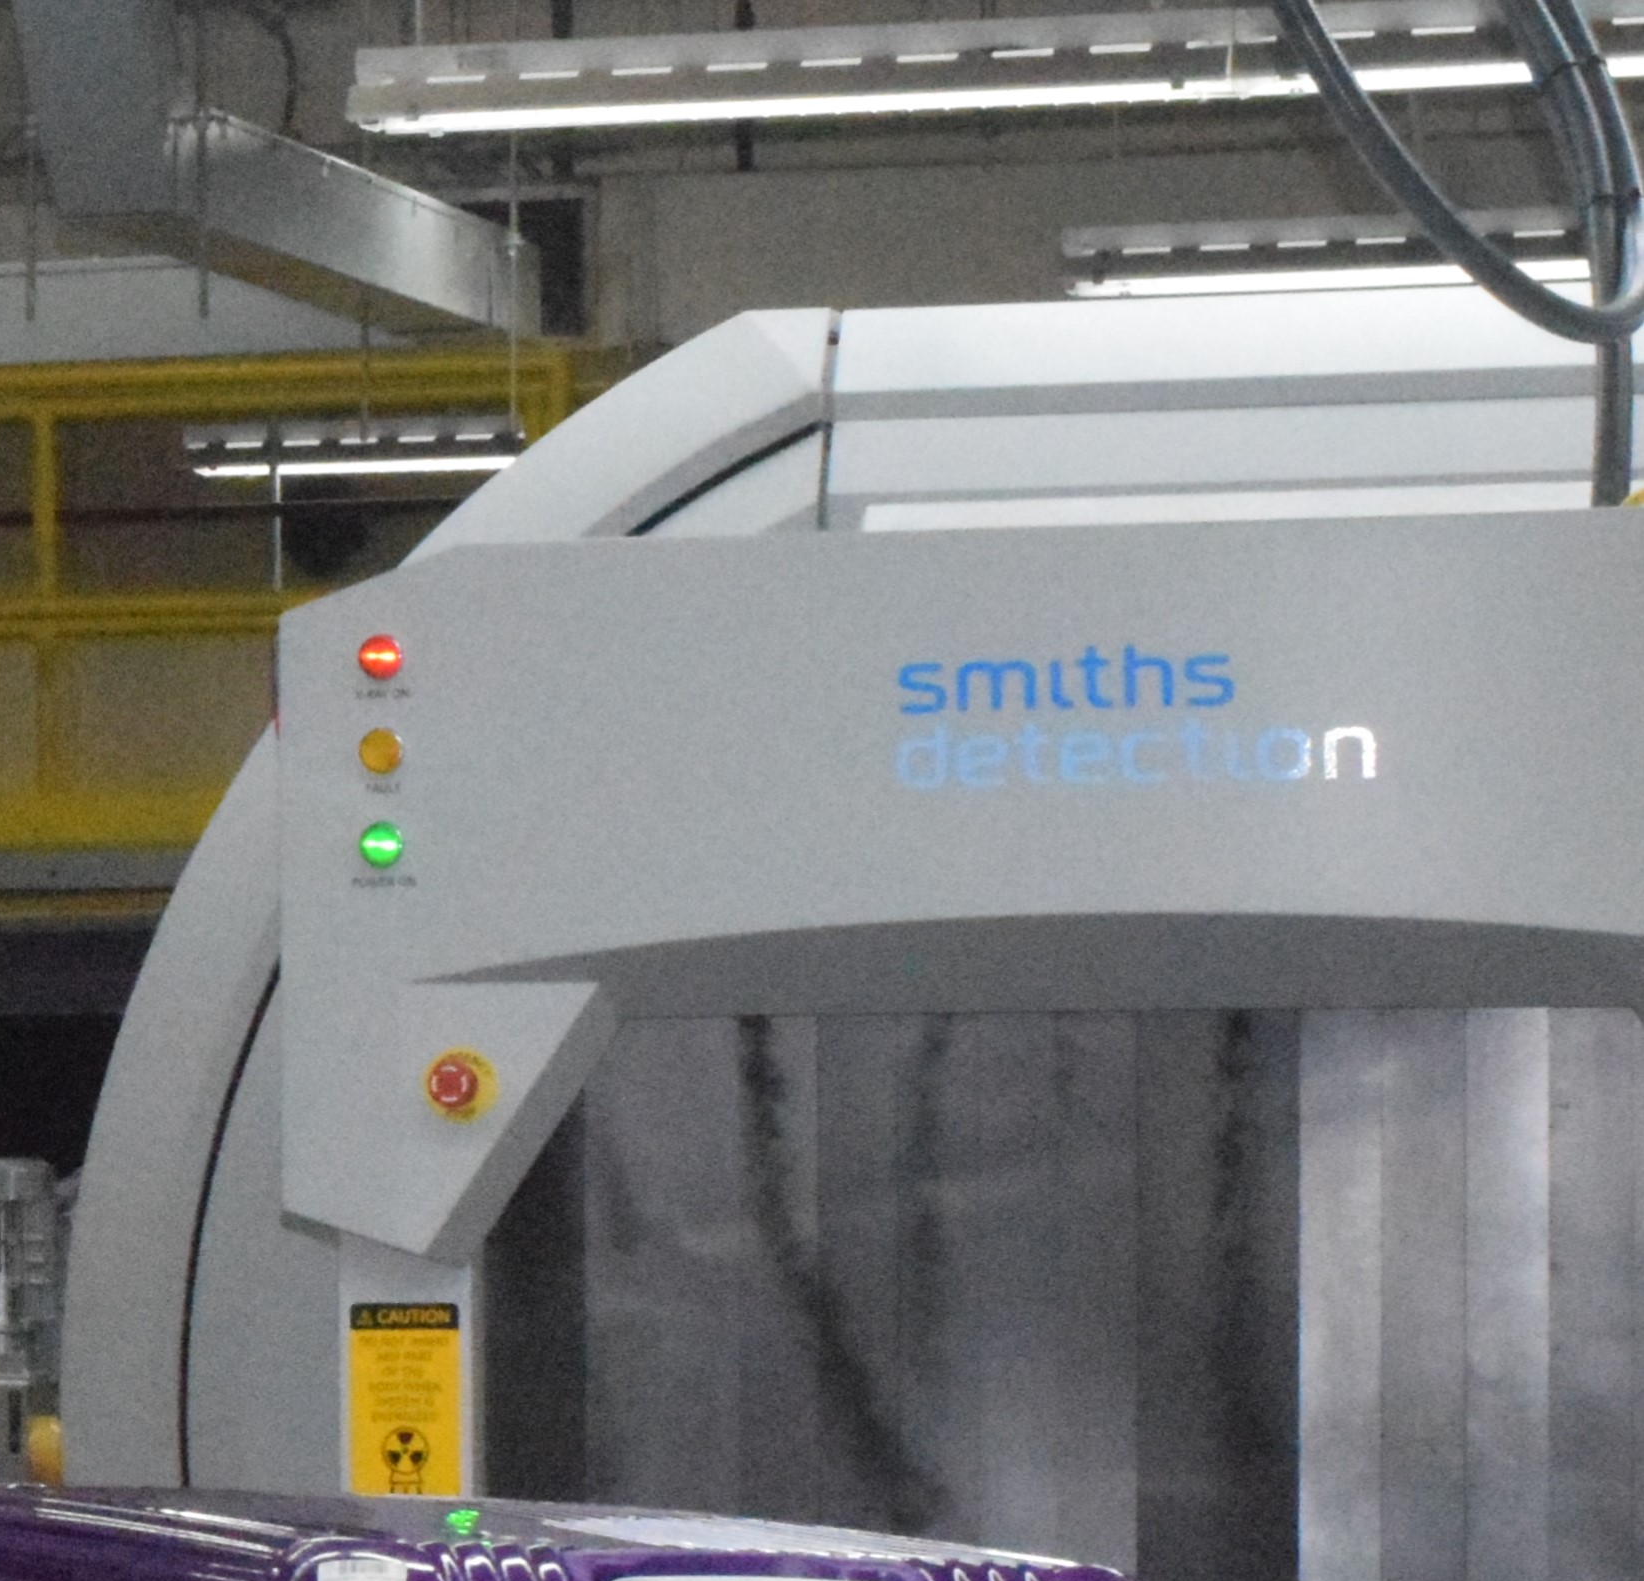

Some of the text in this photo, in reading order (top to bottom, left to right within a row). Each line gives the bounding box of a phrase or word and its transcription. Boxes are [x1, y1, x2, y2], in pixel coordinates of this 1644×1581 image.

[897, 643, 1236, 715] smiths
[894, 717, 1378, 790] detection
[376, 1309, 451, 1324] CAUTION
